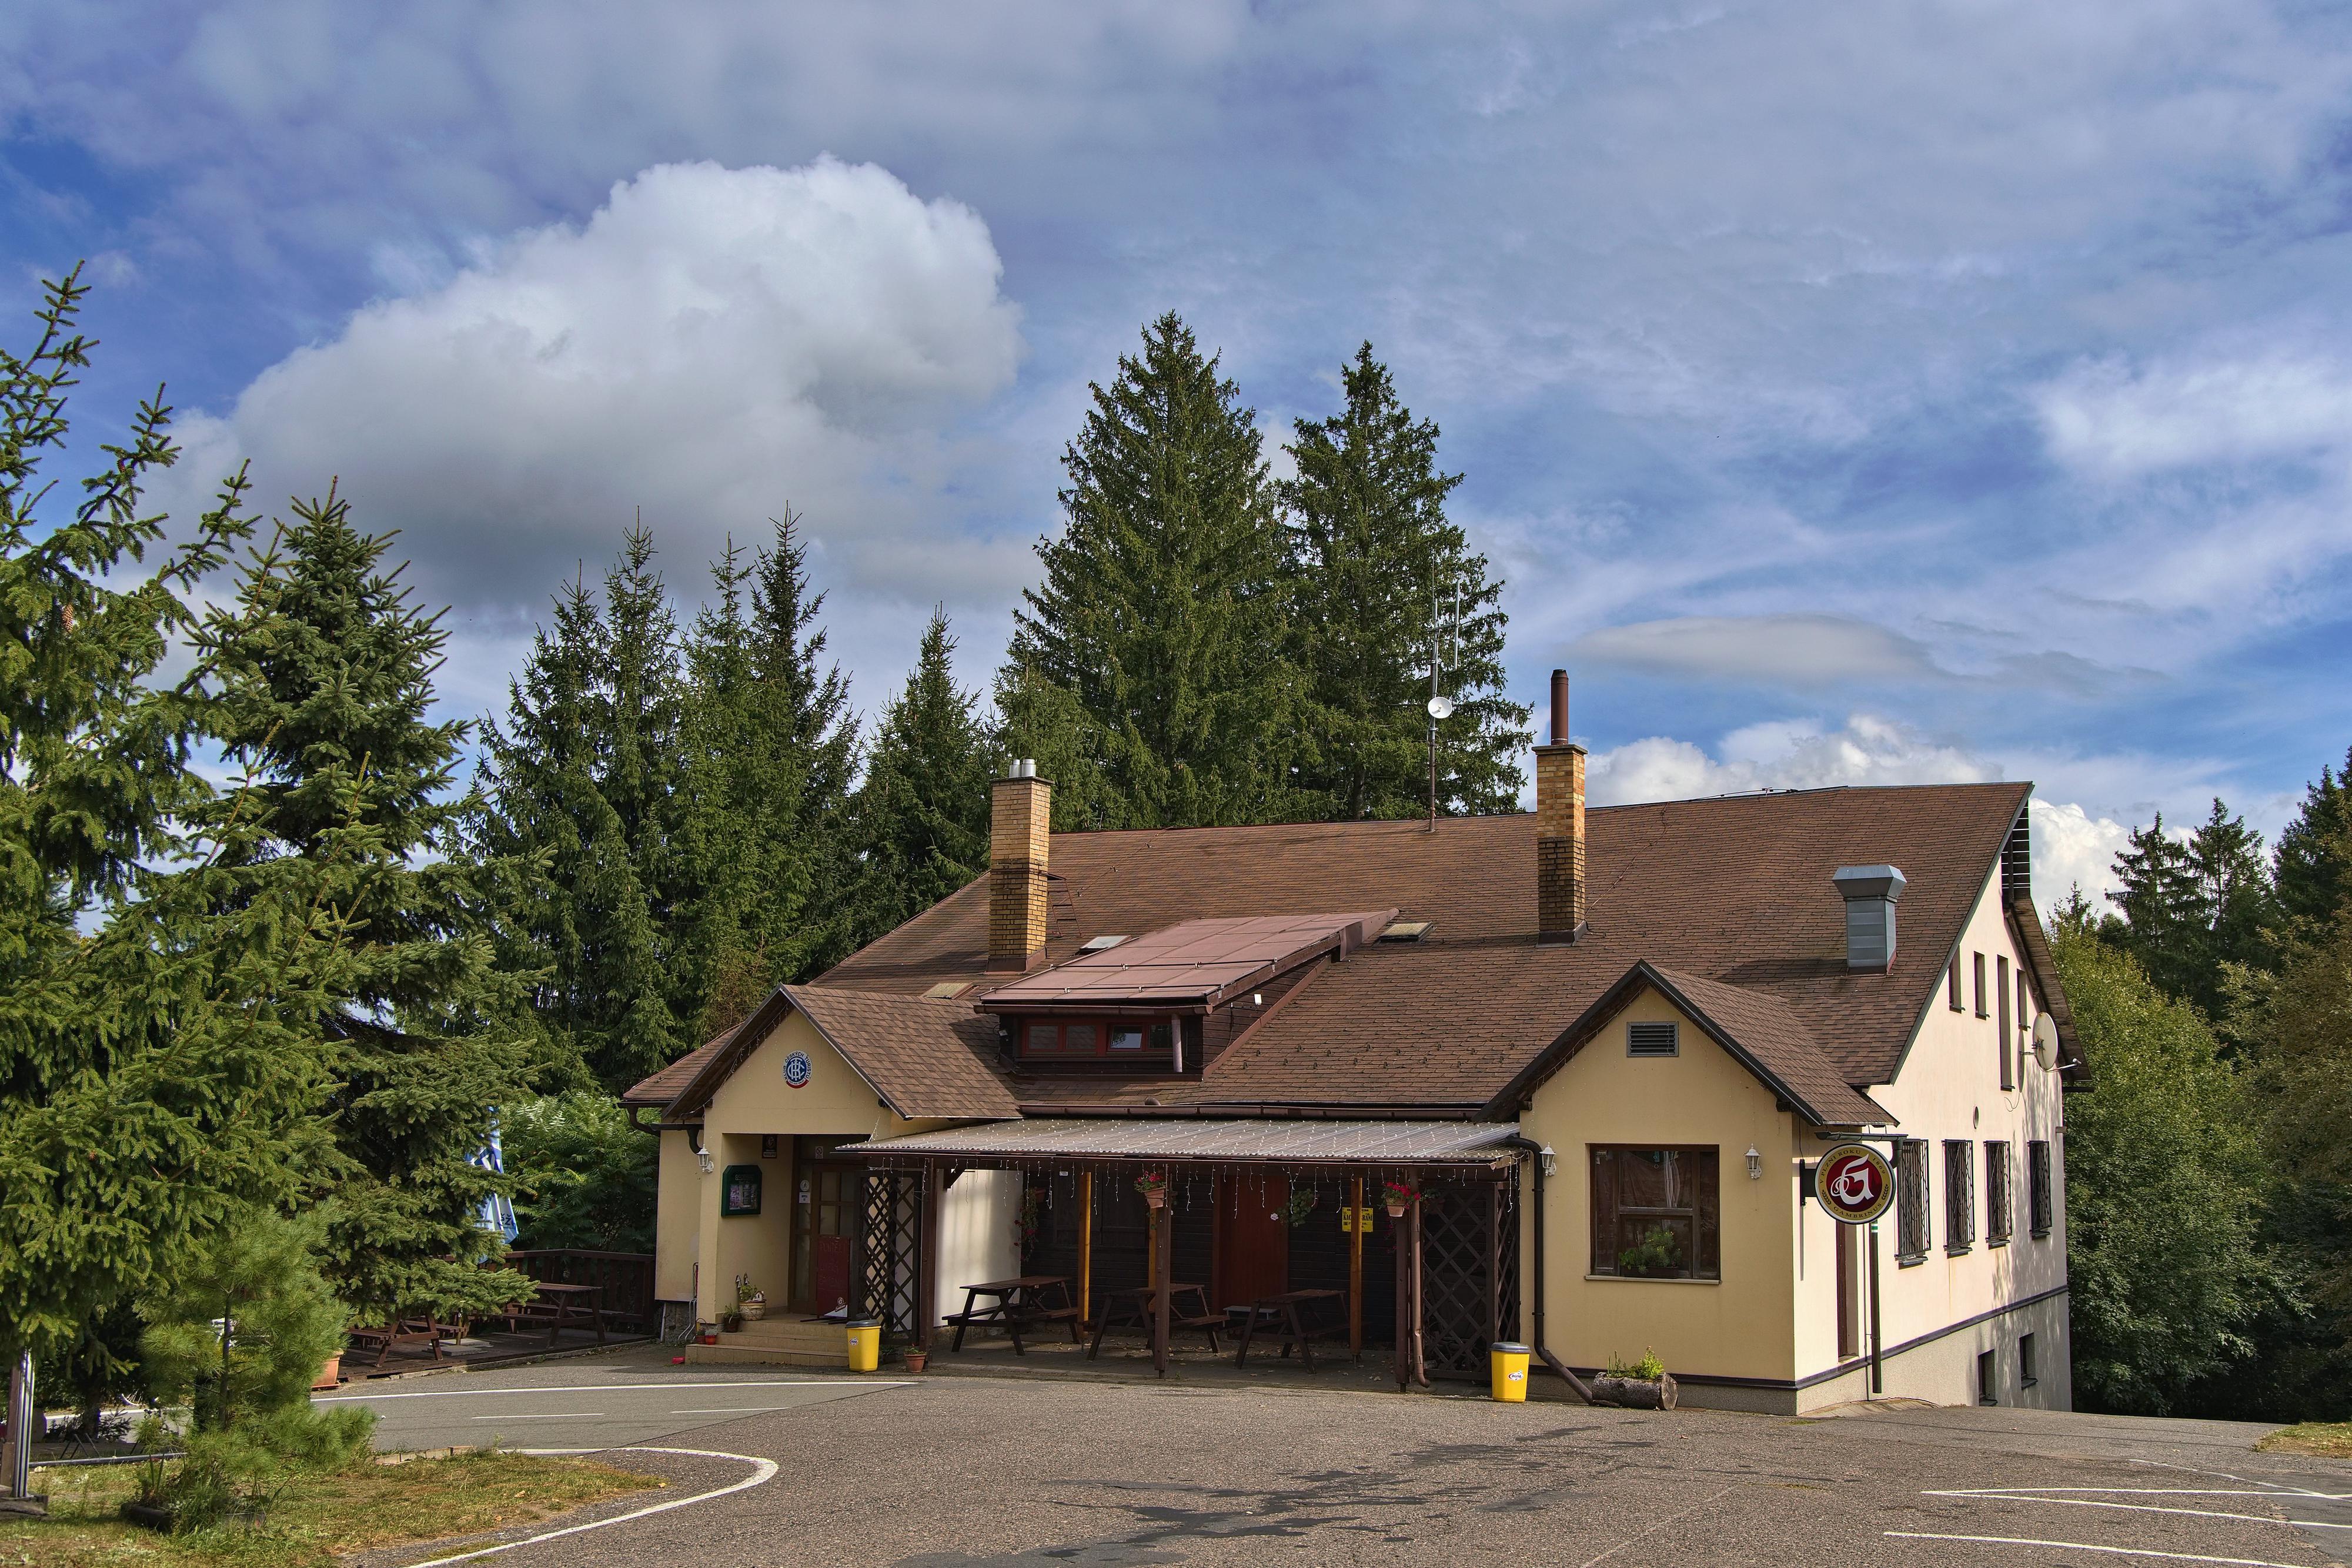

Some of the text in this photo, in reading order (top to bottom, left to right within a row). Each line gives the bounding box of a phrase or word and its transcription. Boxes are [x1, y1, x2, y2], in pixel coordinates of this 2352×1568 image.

[1821, 1156, 1836, 1176] PLZNI
[1872, 1157, 1886, 1174] 1869
[1833, 1203, 1882, 1218] GAMBRINUS
